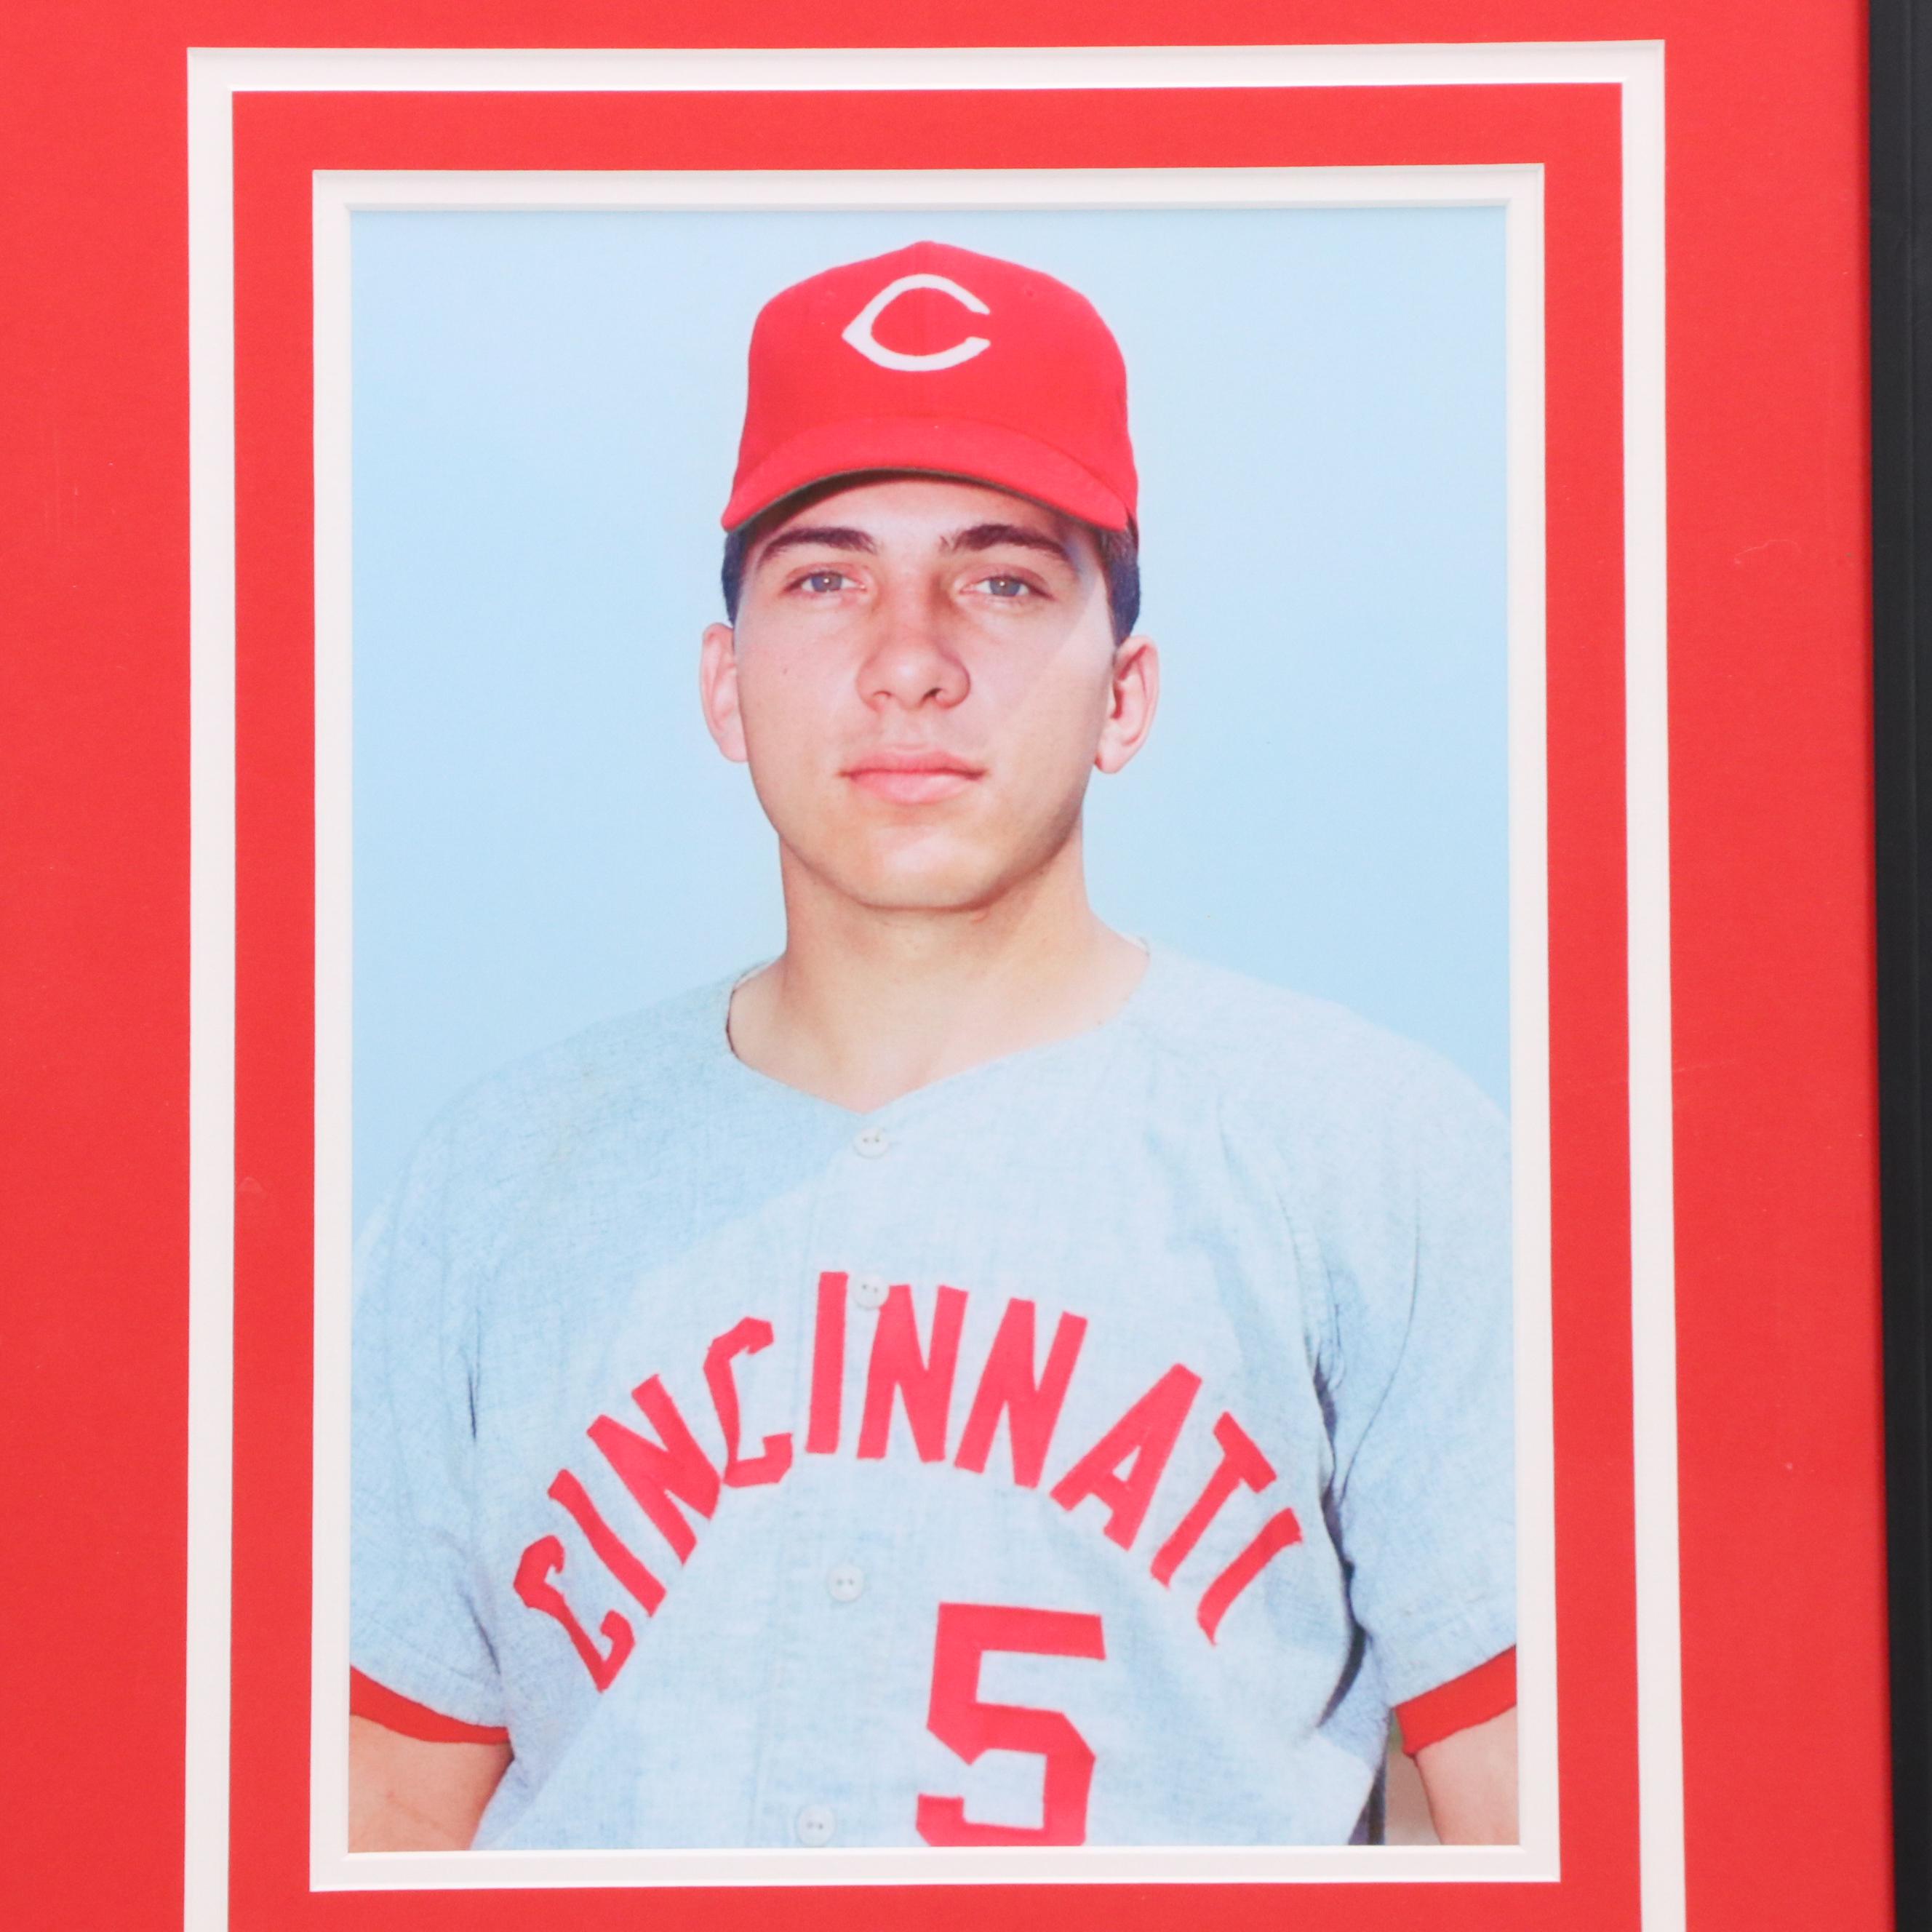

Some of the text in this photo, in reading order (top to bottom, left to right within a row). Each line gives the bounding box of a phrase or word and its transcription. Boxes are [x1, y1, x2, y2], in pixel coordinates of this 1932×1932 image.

[842, 273, 991, 372] C
[513, 1271, 1304, 1692] CINCINNATI
[915, 1601, 1107, 1848] 5
